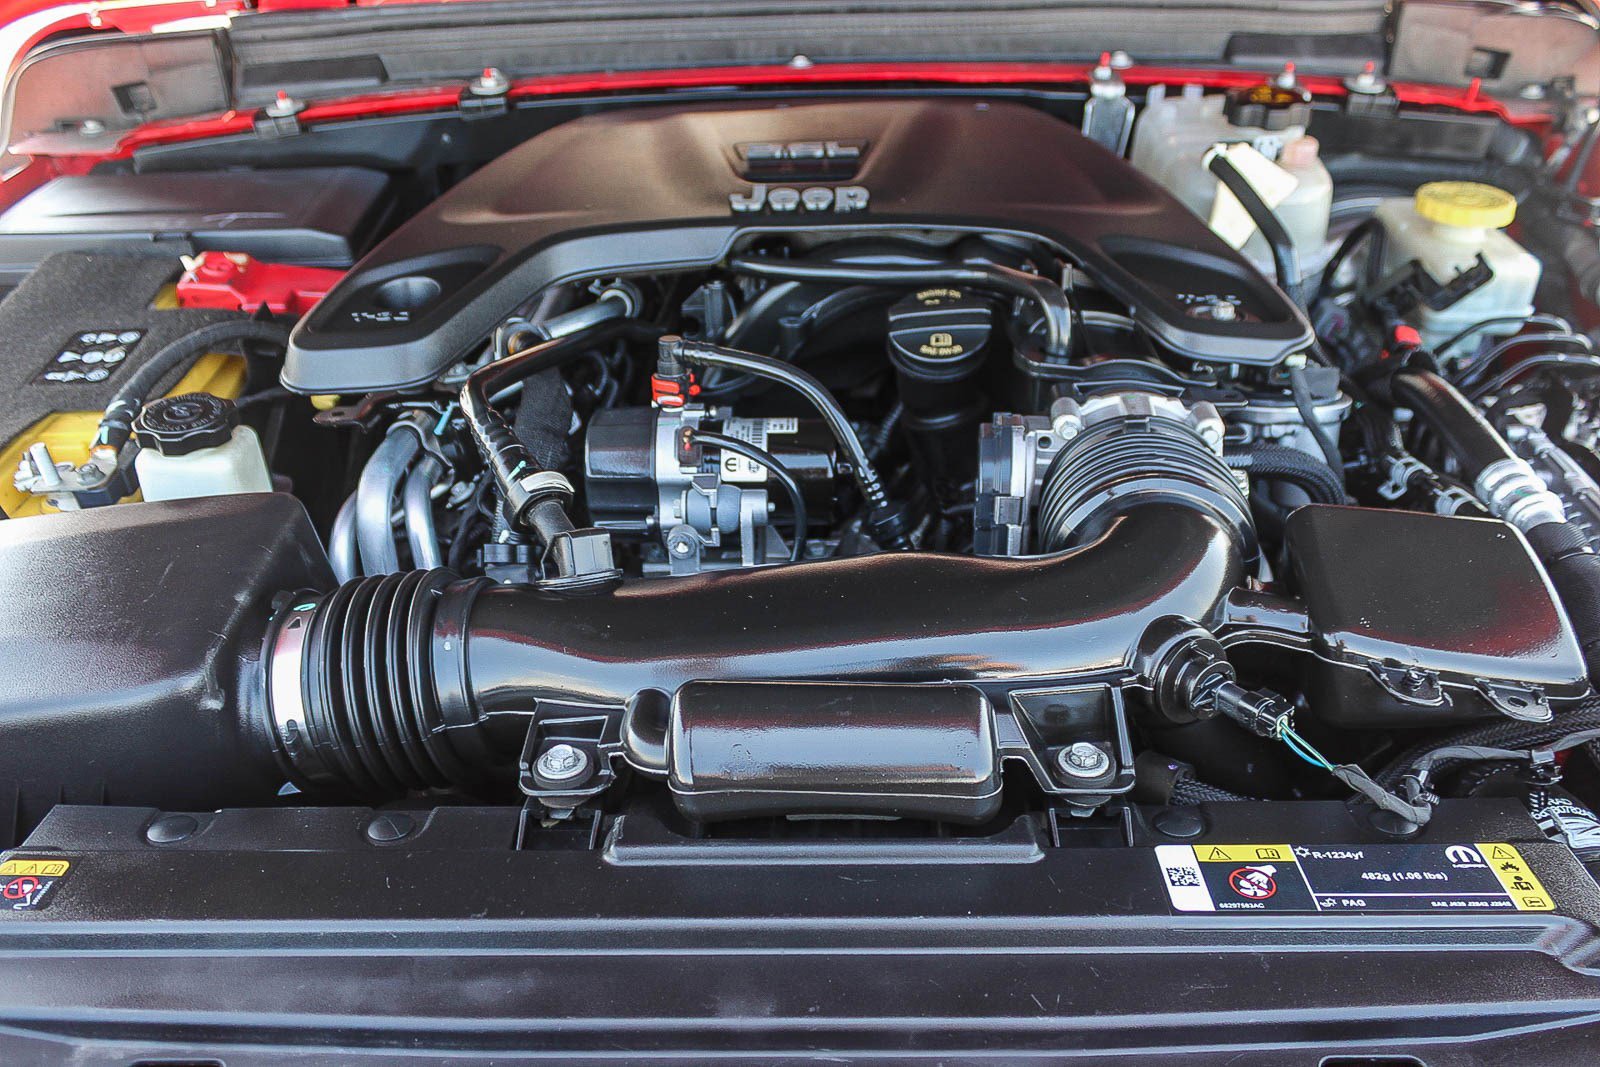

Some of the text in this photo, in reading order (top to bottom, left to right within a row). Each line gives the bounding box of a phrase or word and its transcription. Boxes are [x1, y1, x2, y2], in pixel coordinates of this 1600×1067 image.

[729, 184, 869, 213] Jeep
[1312, 851, 1364, 860] R-1234yf
[1361, 872, 1391, 882] 482g
[1425, 872, 1449, 882] lbs)
[1341, 899, 1366, 907] PAG
